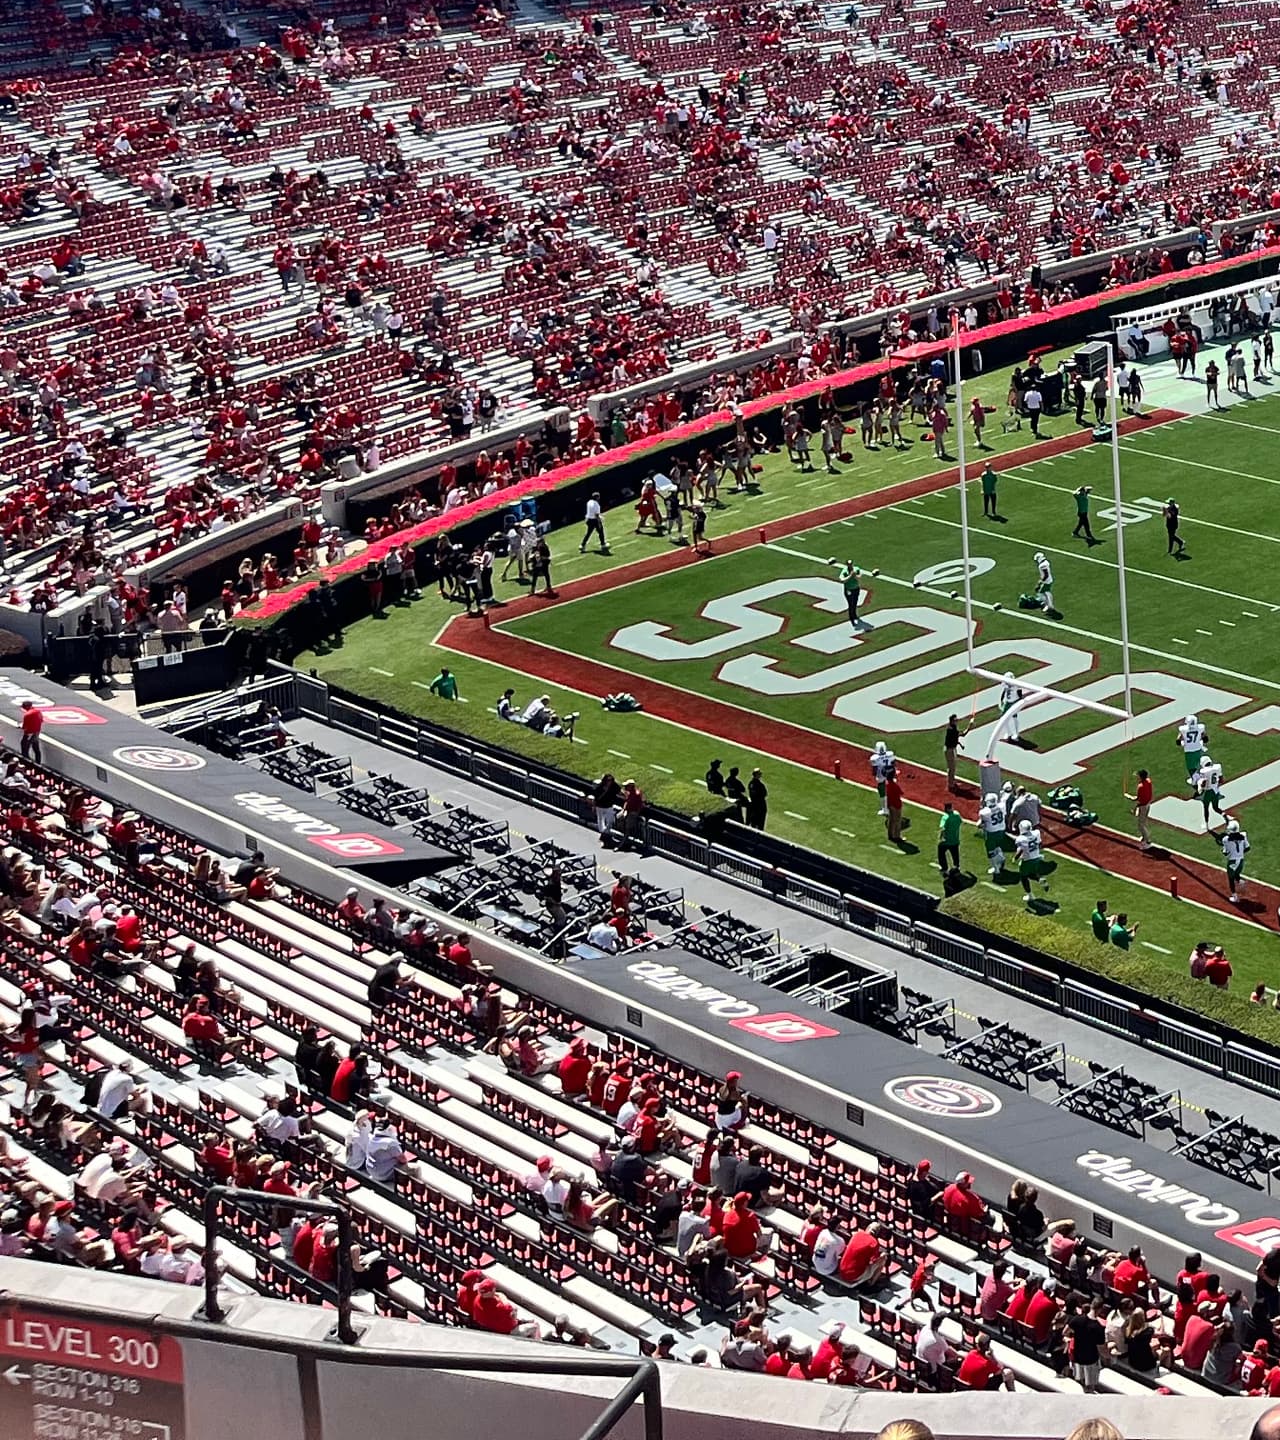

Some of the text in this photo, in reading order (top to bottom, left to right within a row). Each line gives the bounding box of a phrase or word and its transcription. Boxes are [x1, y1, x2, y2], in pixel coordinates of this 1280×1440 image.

[1185, 730, 1199, 744] 57
[626, 960, 760, 1018] QuikTrip
[1076, 1149, 1240, 1227] QuikTrip
[6, 1319, 159, 1369] LEVEL 300
[32, 1363, 109, 1388] SECTION
[32, 1380, 114, 1407] ROW 1-10
[32, 1403, 143, 1435] SECTION 316
[32, 1420, 79, 1440] ROW
